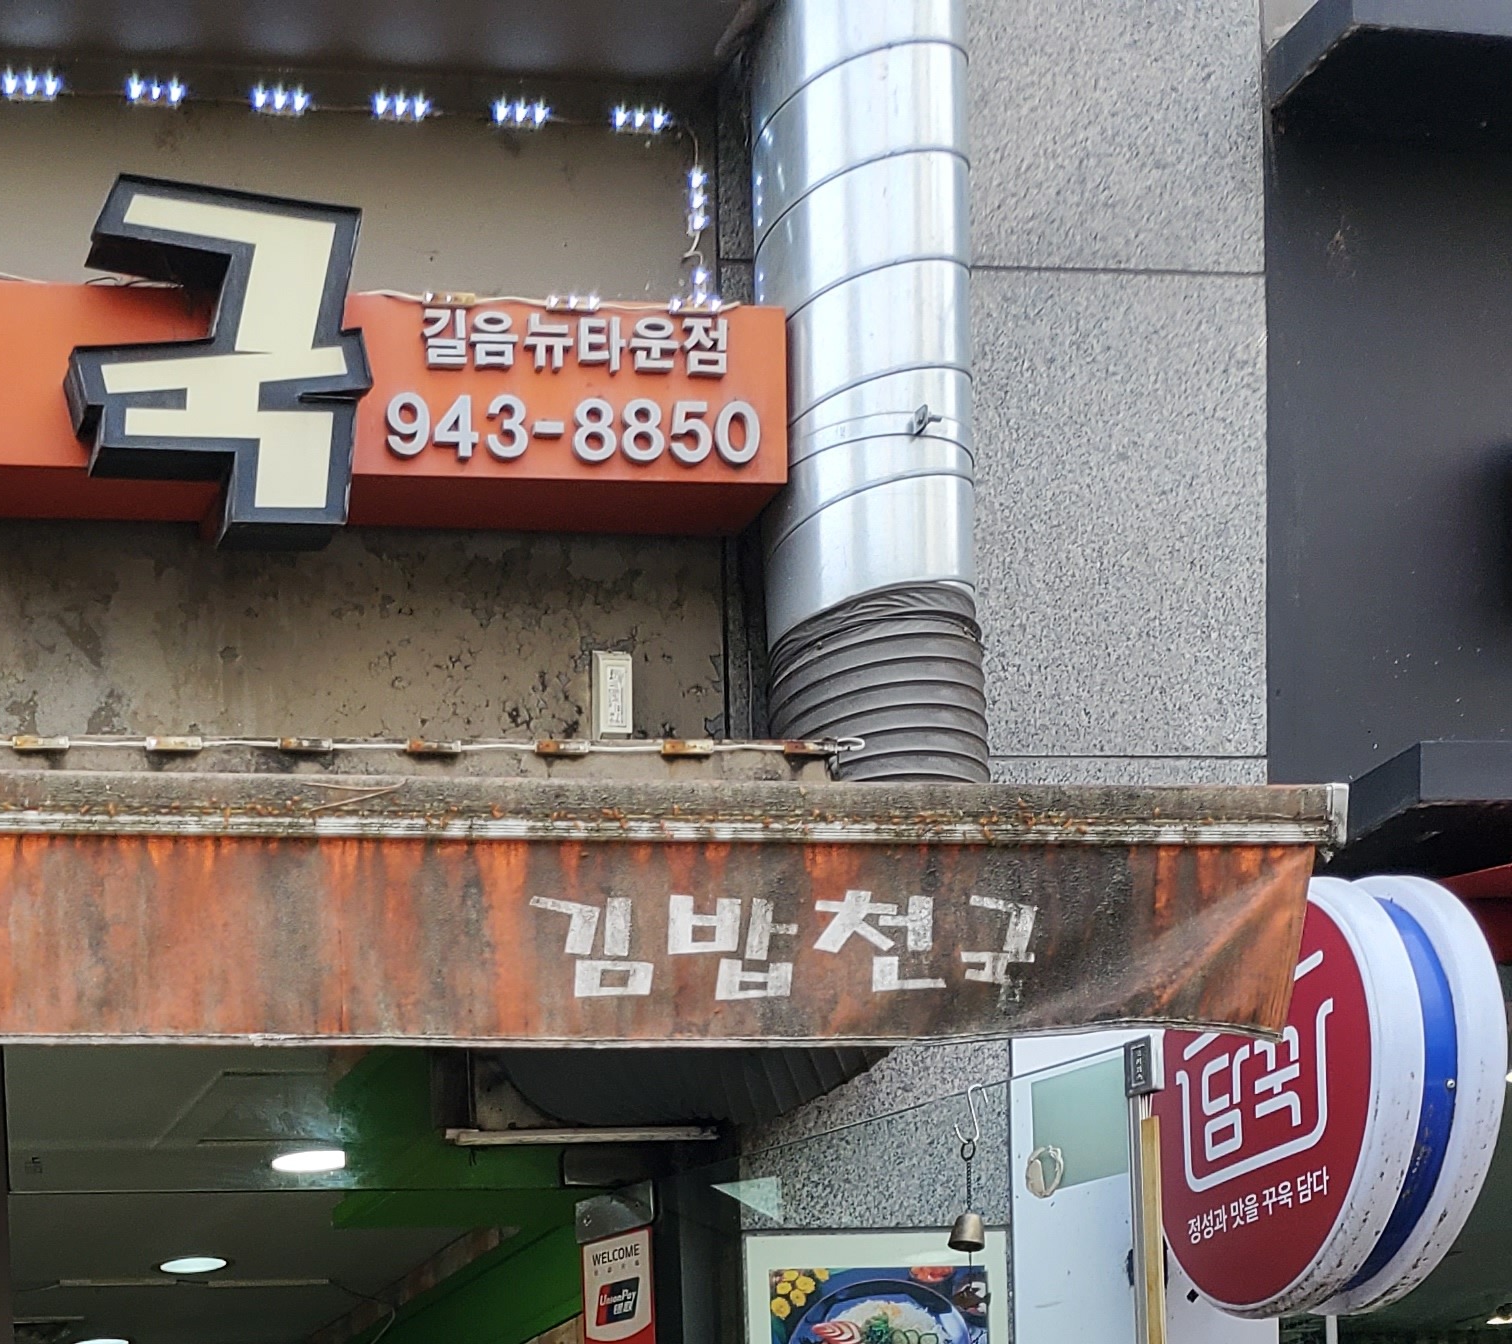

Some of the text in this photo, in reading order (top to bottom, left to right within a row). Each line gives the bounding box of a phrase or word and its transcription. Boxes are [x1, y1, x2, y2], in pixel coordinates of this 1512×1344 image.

[423, 308, 729, 378] 길음뉴타운점
[386, 391, 762, 468] 943-8850
[529, 889, 1037, 1002] 김밥천국
[1187, 1165, 1330, 1245] 정성과 맛을 꾸욱 담다
[591, 1243, 640, 1267] WELCOME
